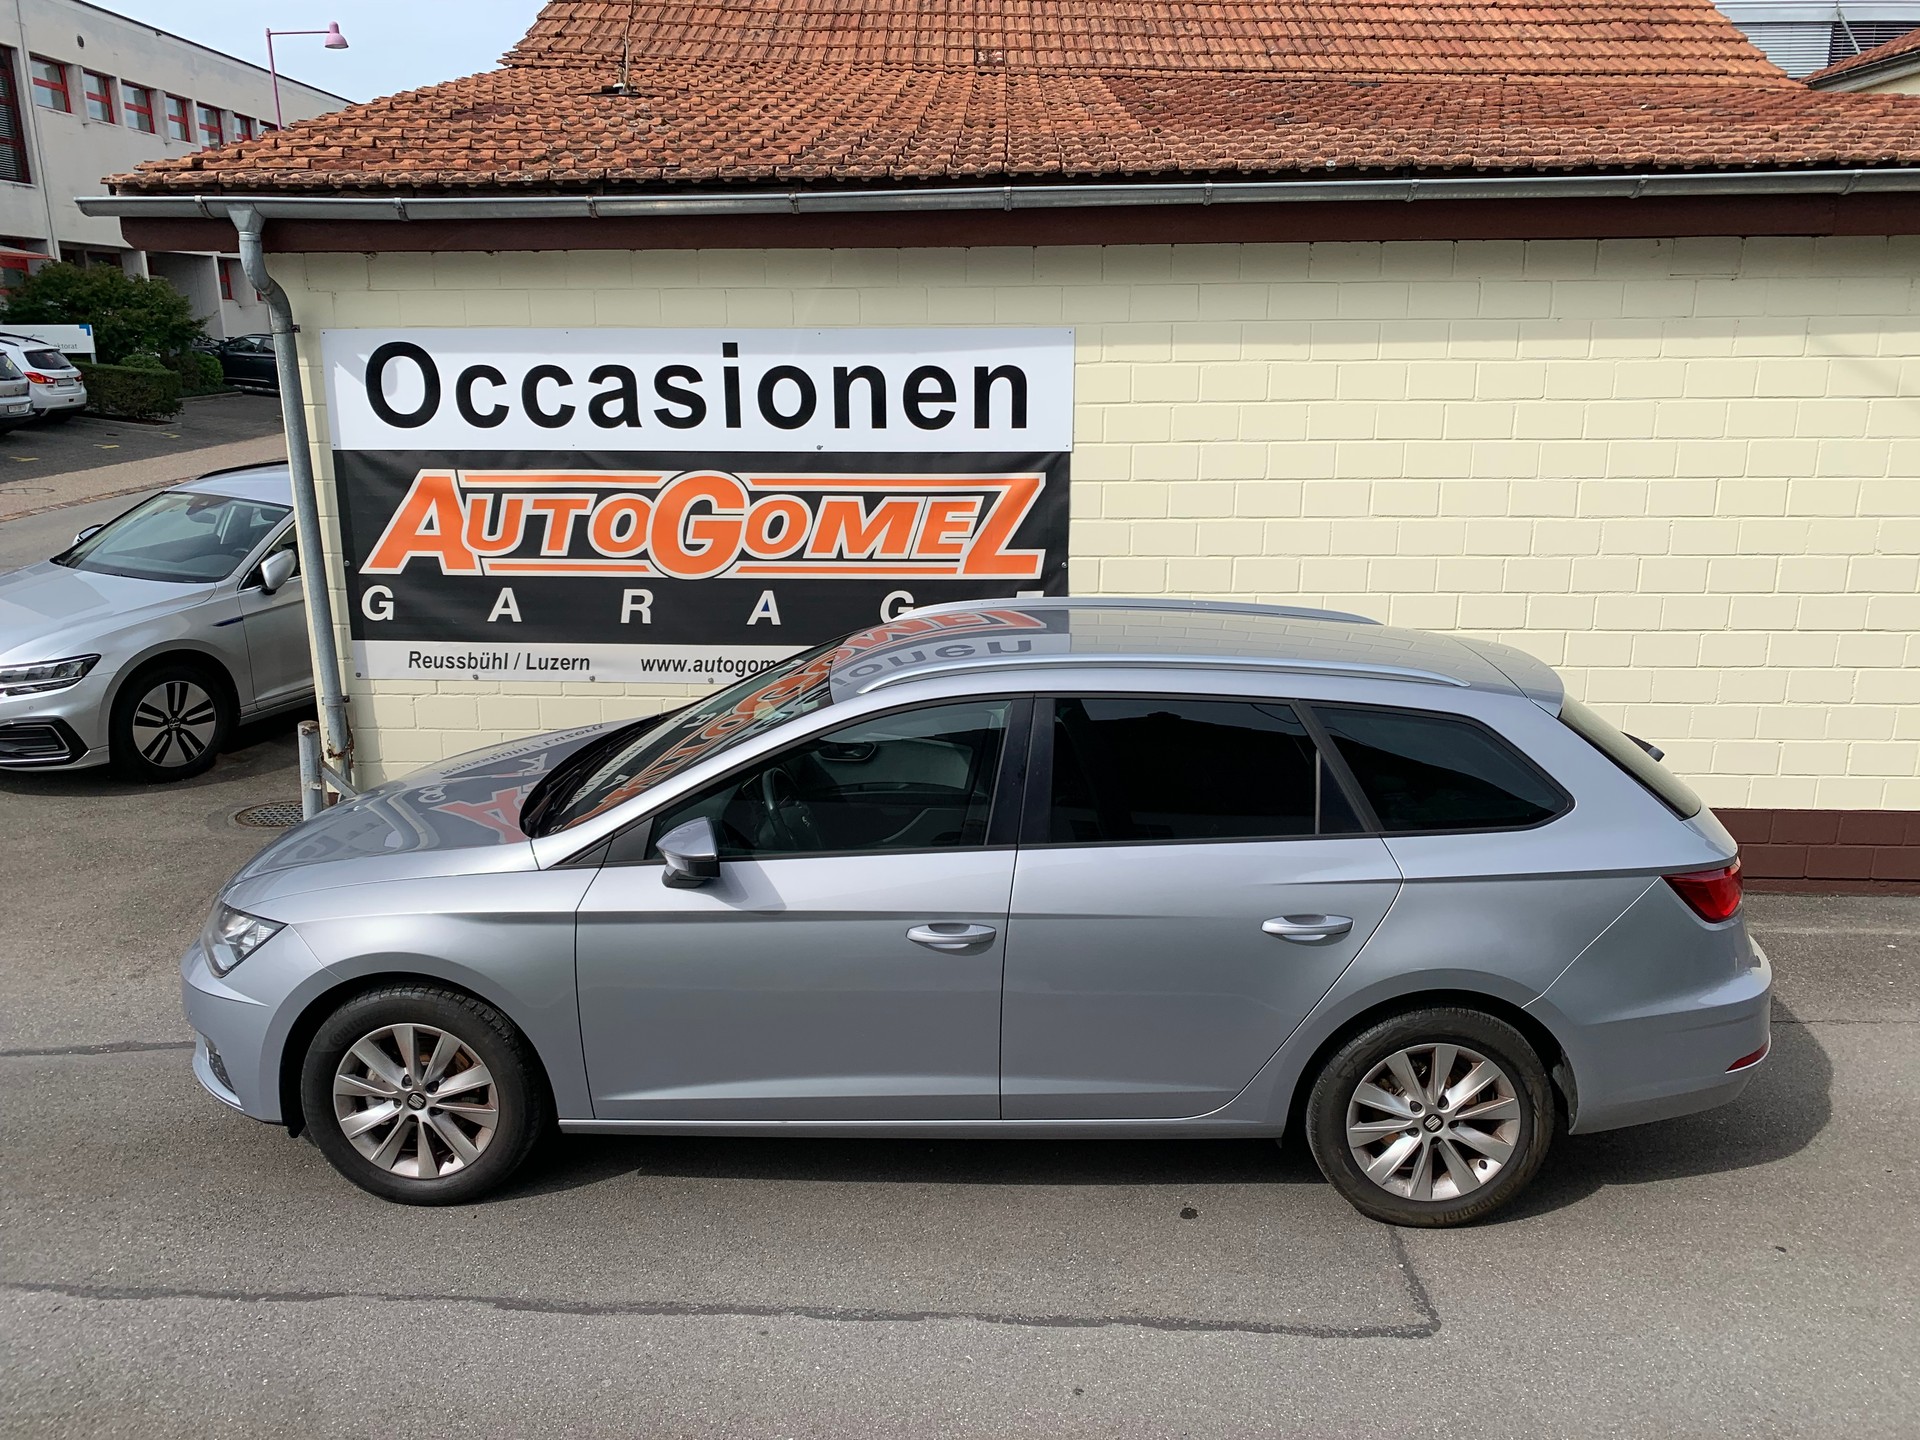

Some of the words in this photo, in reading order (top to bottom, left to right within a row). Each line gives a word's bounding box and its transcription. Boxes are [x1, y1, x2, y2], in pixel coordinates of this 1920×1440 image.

[365, 341, 1028, 429] Occasionen
[408, 651, 509, 670] Reussbühl
[526, 654, 591, 671] Luzern
